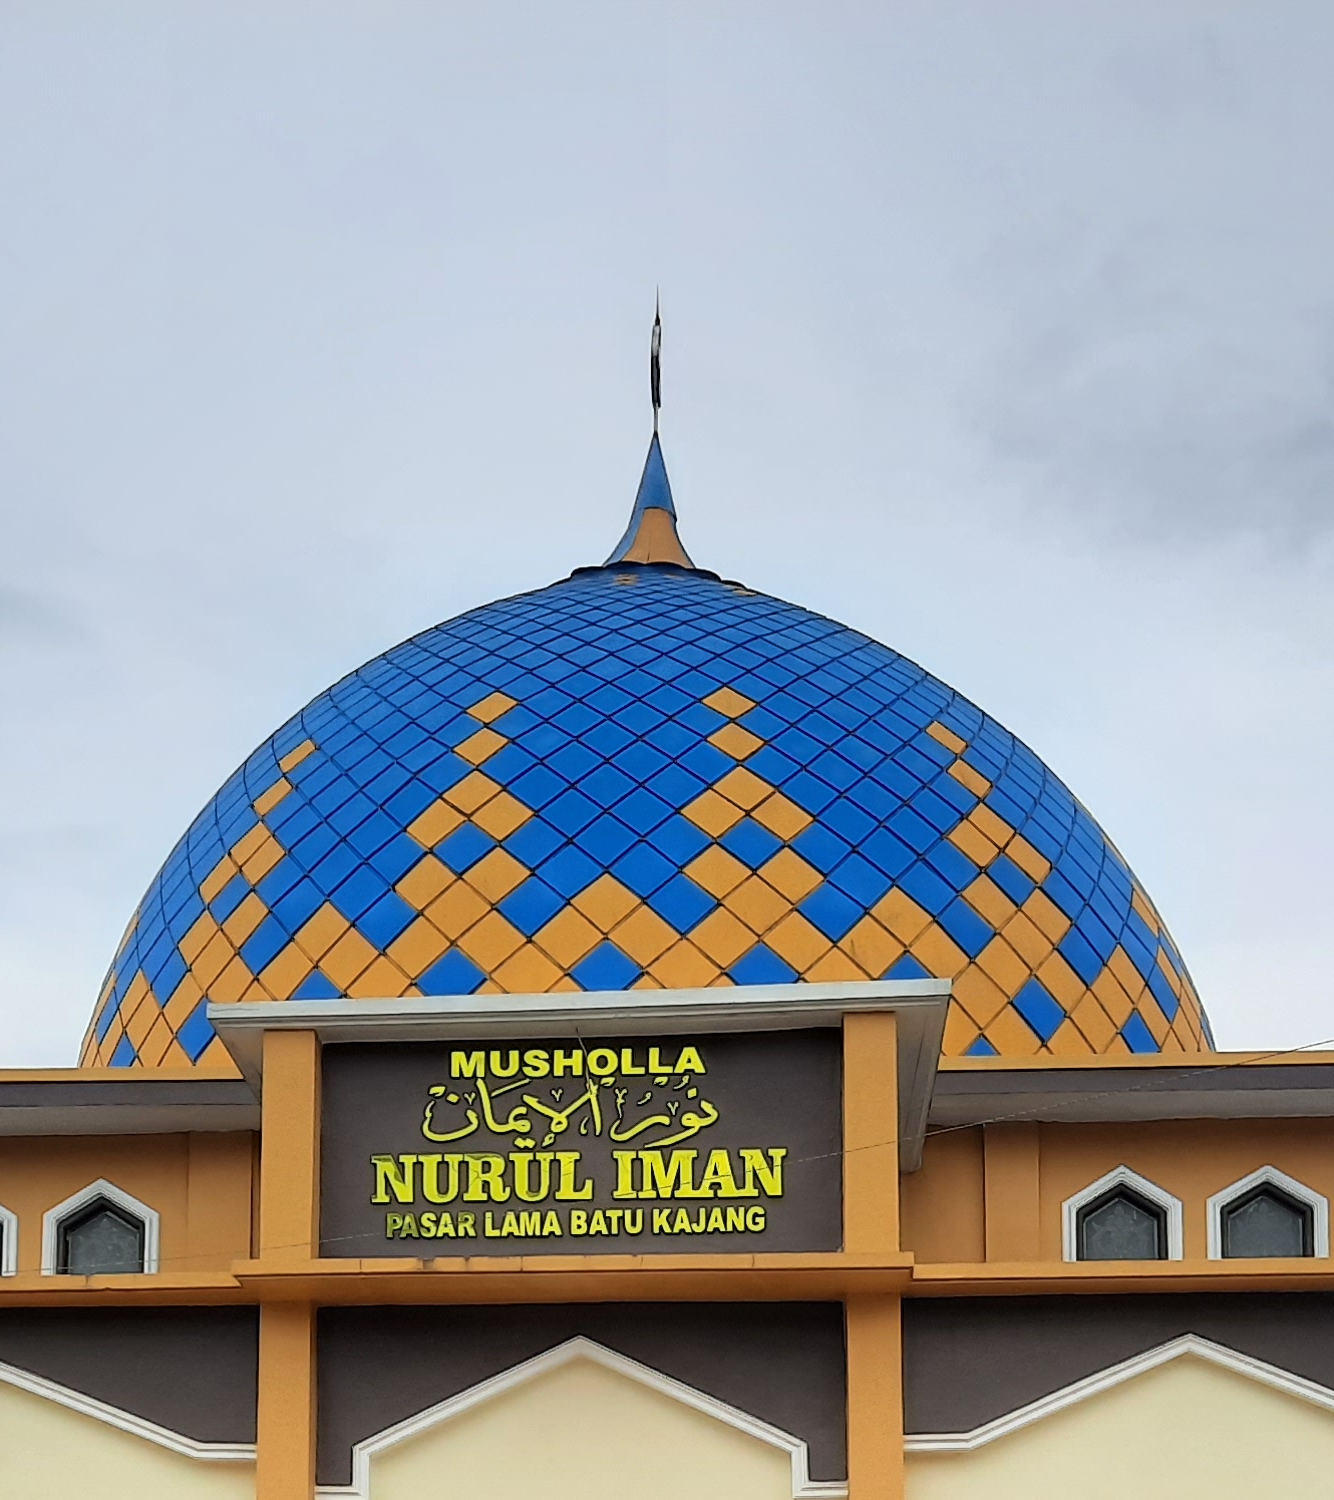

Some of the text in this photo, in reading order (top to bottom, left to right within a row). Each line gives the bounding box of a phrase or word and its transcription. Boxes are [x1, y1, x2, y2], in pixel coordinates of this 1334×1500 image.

[449, 1045, 707, 1079] MUSHOLLA
[371, 1148, 788, 1204] NURUL IMAN
[386, 1205, 766, 1239] PASAR LAMA BATU KAJANG
